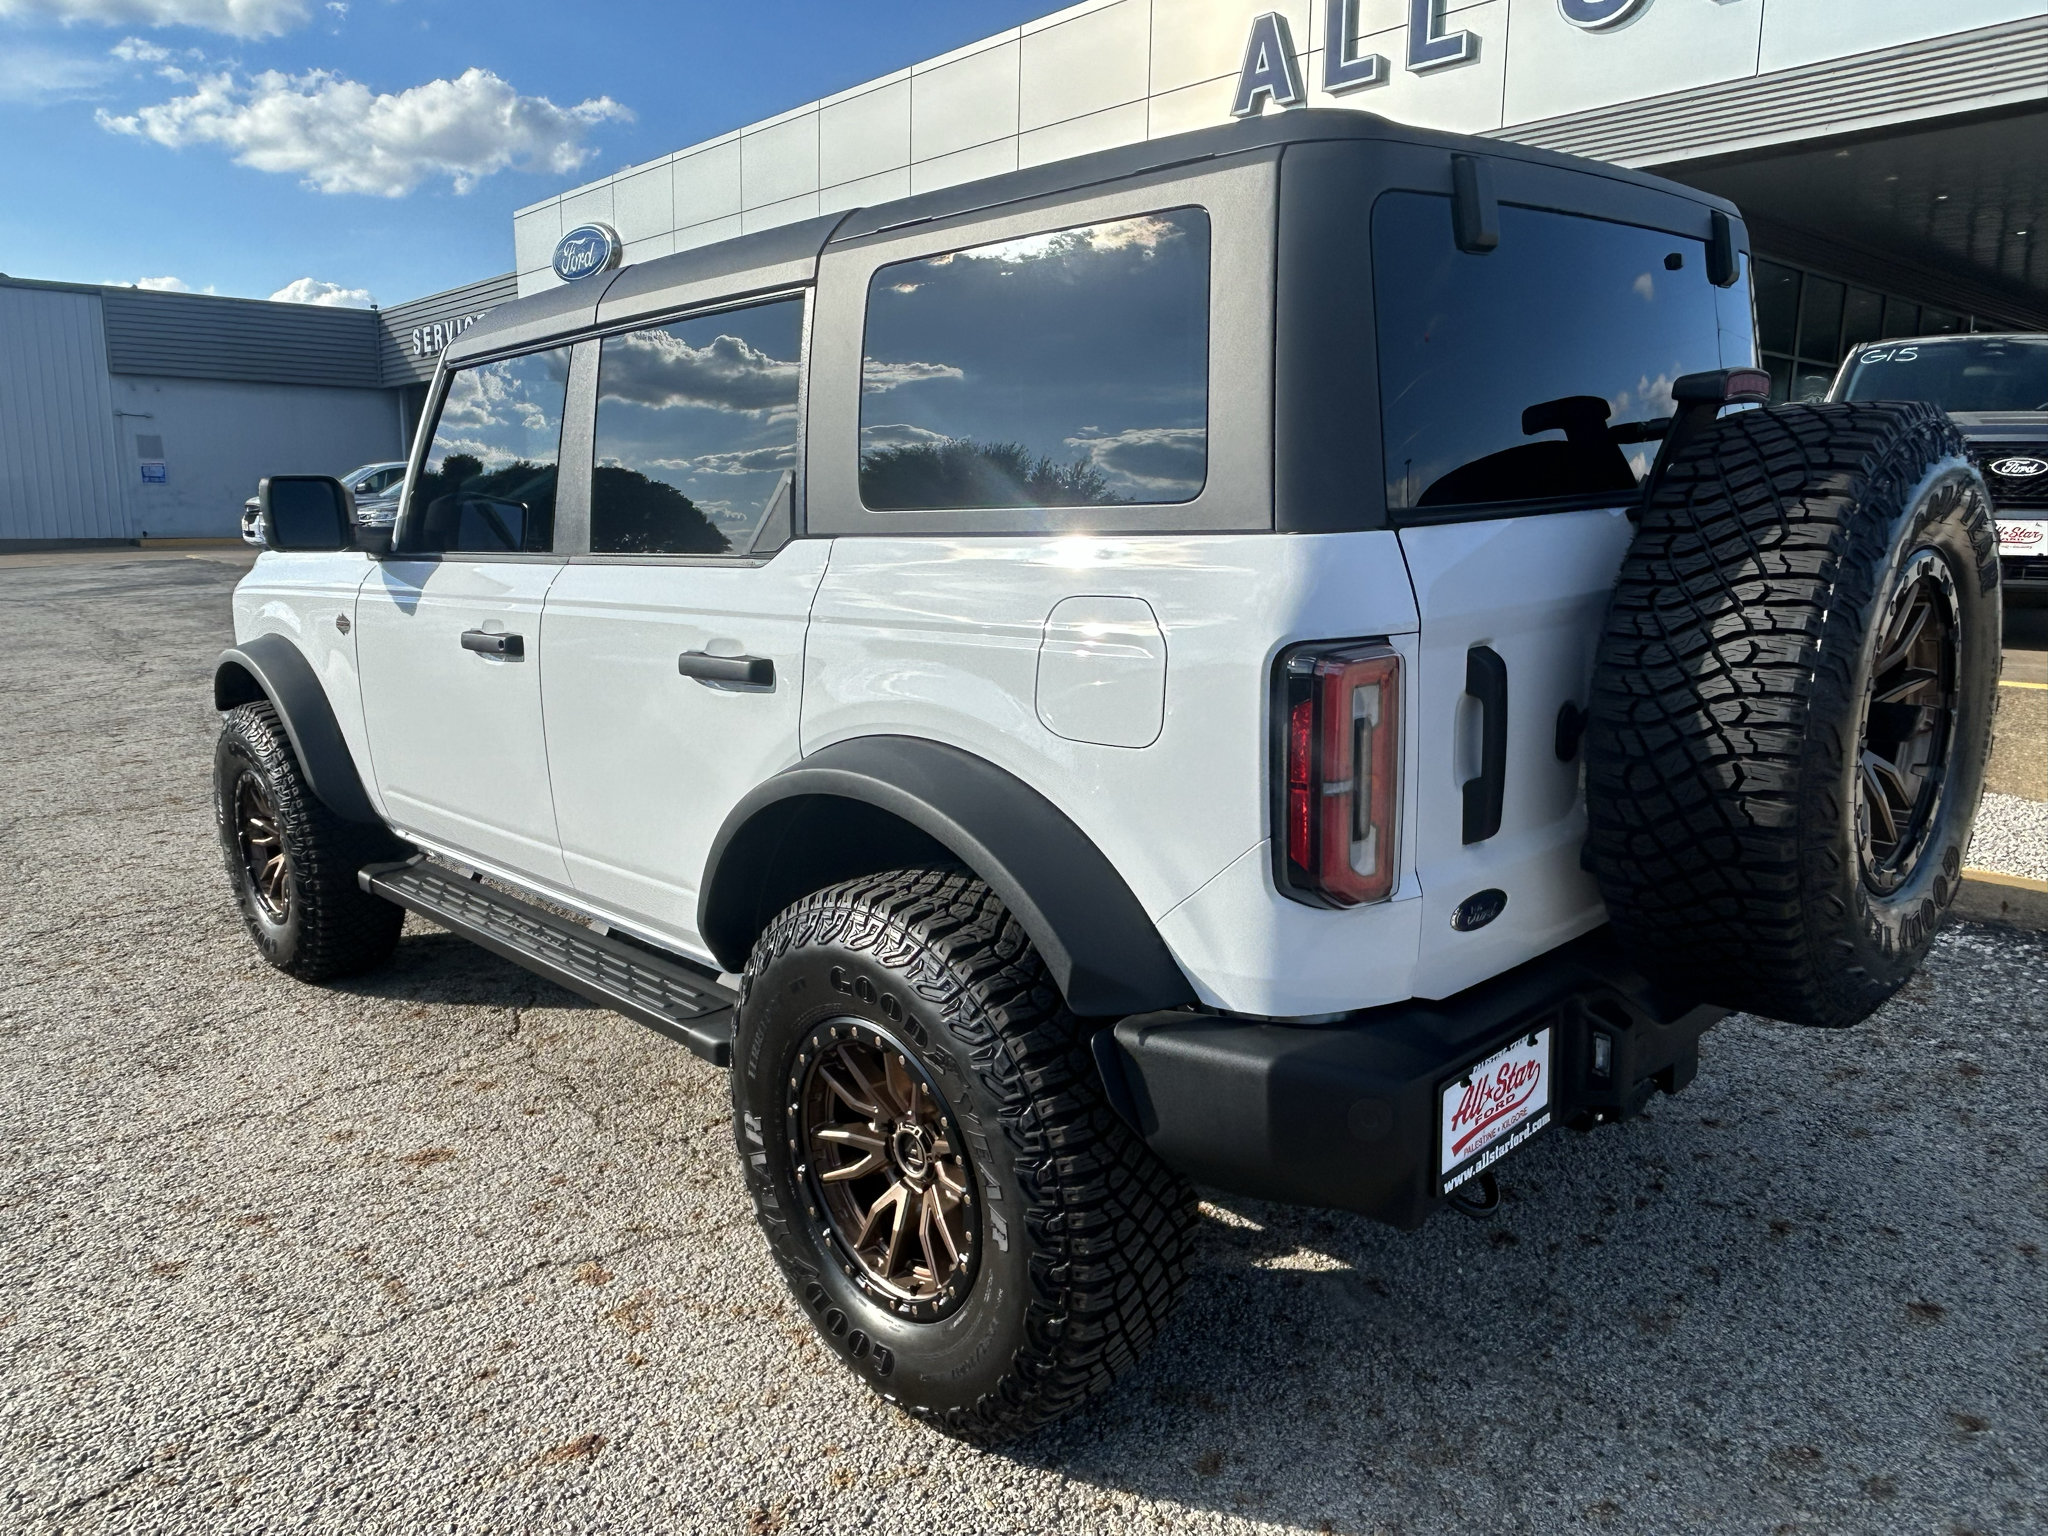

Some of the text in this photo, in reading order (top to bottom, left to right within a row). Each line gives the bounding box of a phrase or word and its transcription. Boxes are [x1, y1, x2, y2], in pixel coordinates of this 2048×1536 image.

[1229, 0, 1480, 118] ALL
[561, 237, 597, 274] Ford
[412, 312, 485, 355] SERVI
[2001, 460, 2040, 473] Ford
[829, 965, 1009, 1252] GOODYEAR
[1462, 1106, 1529, 1159] PALESTINE KILGORE
[1474, 1093, 1516, 1127] FORD
[1443, 1112, 1551, 1195] www.allstarford.com
[743, 1110, 896, 1378] GOODYEAR
